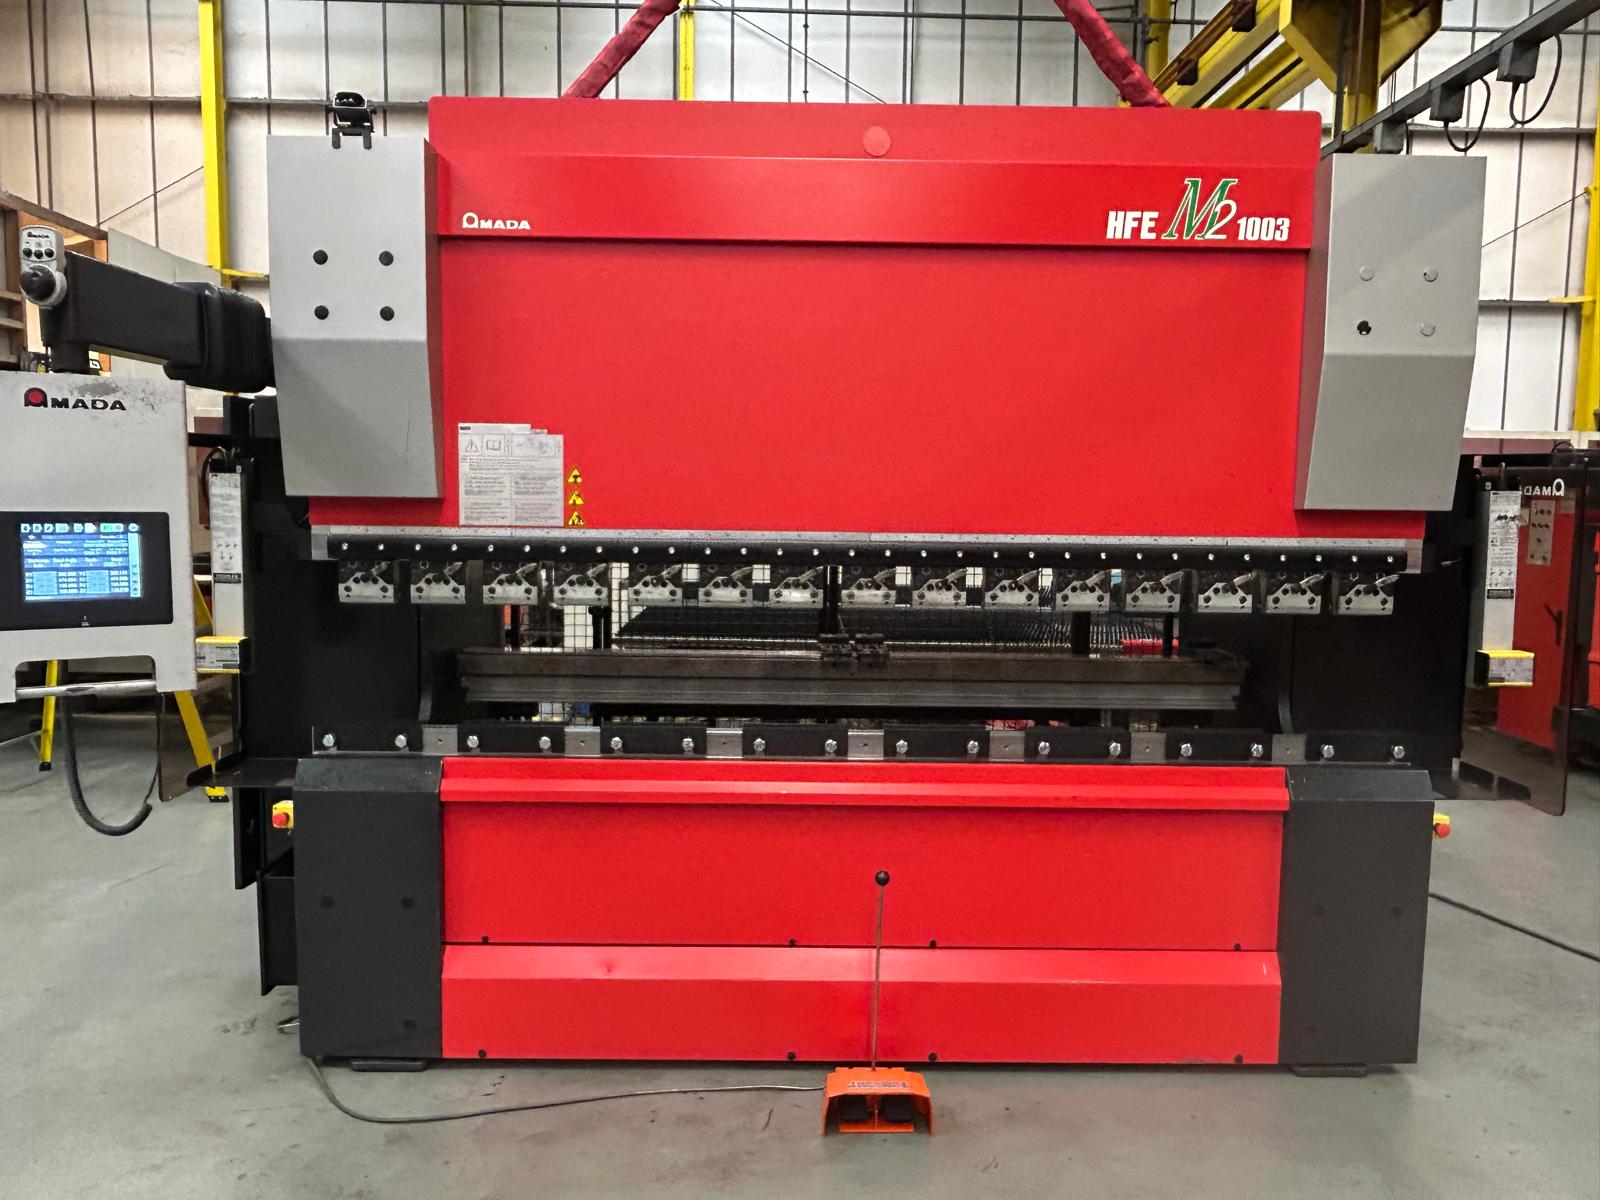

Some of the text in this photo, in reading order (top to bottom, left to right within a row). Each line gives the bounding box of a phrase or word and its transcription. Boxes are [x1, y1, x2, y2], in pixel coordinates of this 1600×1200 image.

[462, 211, 531, 230] AMADA
[1106, 210, 1159, 239] HFE
[1237, 216, 1290, 242] 1003
[24, 387, 127, 411] AMADA
